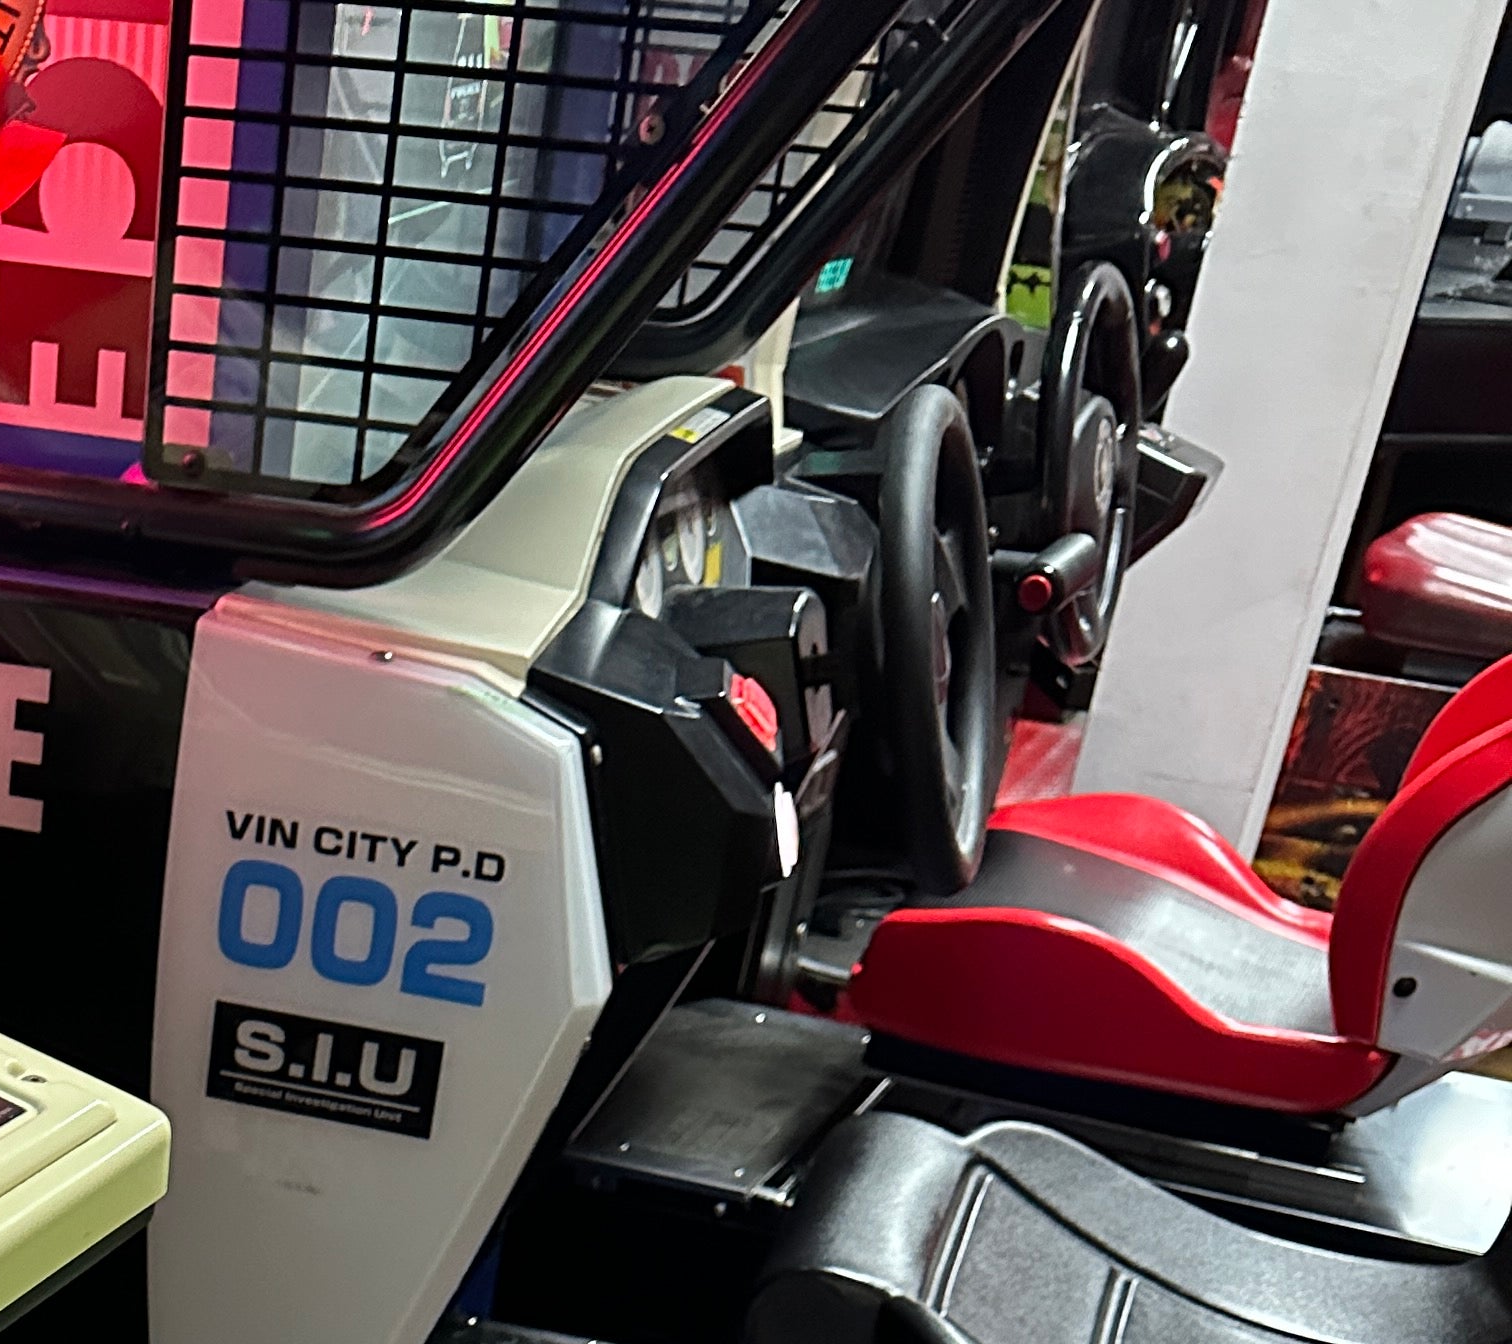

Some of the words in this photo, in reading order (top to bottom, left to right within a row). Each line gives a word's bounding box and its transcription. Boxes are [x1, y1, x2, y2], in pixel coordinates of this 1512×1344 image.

[225, 809, 299, 850] VIN
[312, 821, 419, 868] CITY
[431, 844, 507, 884] P.D
[216, 859, 496, 1007] 002
[234, 1019, 417, 1096] S.I.U
